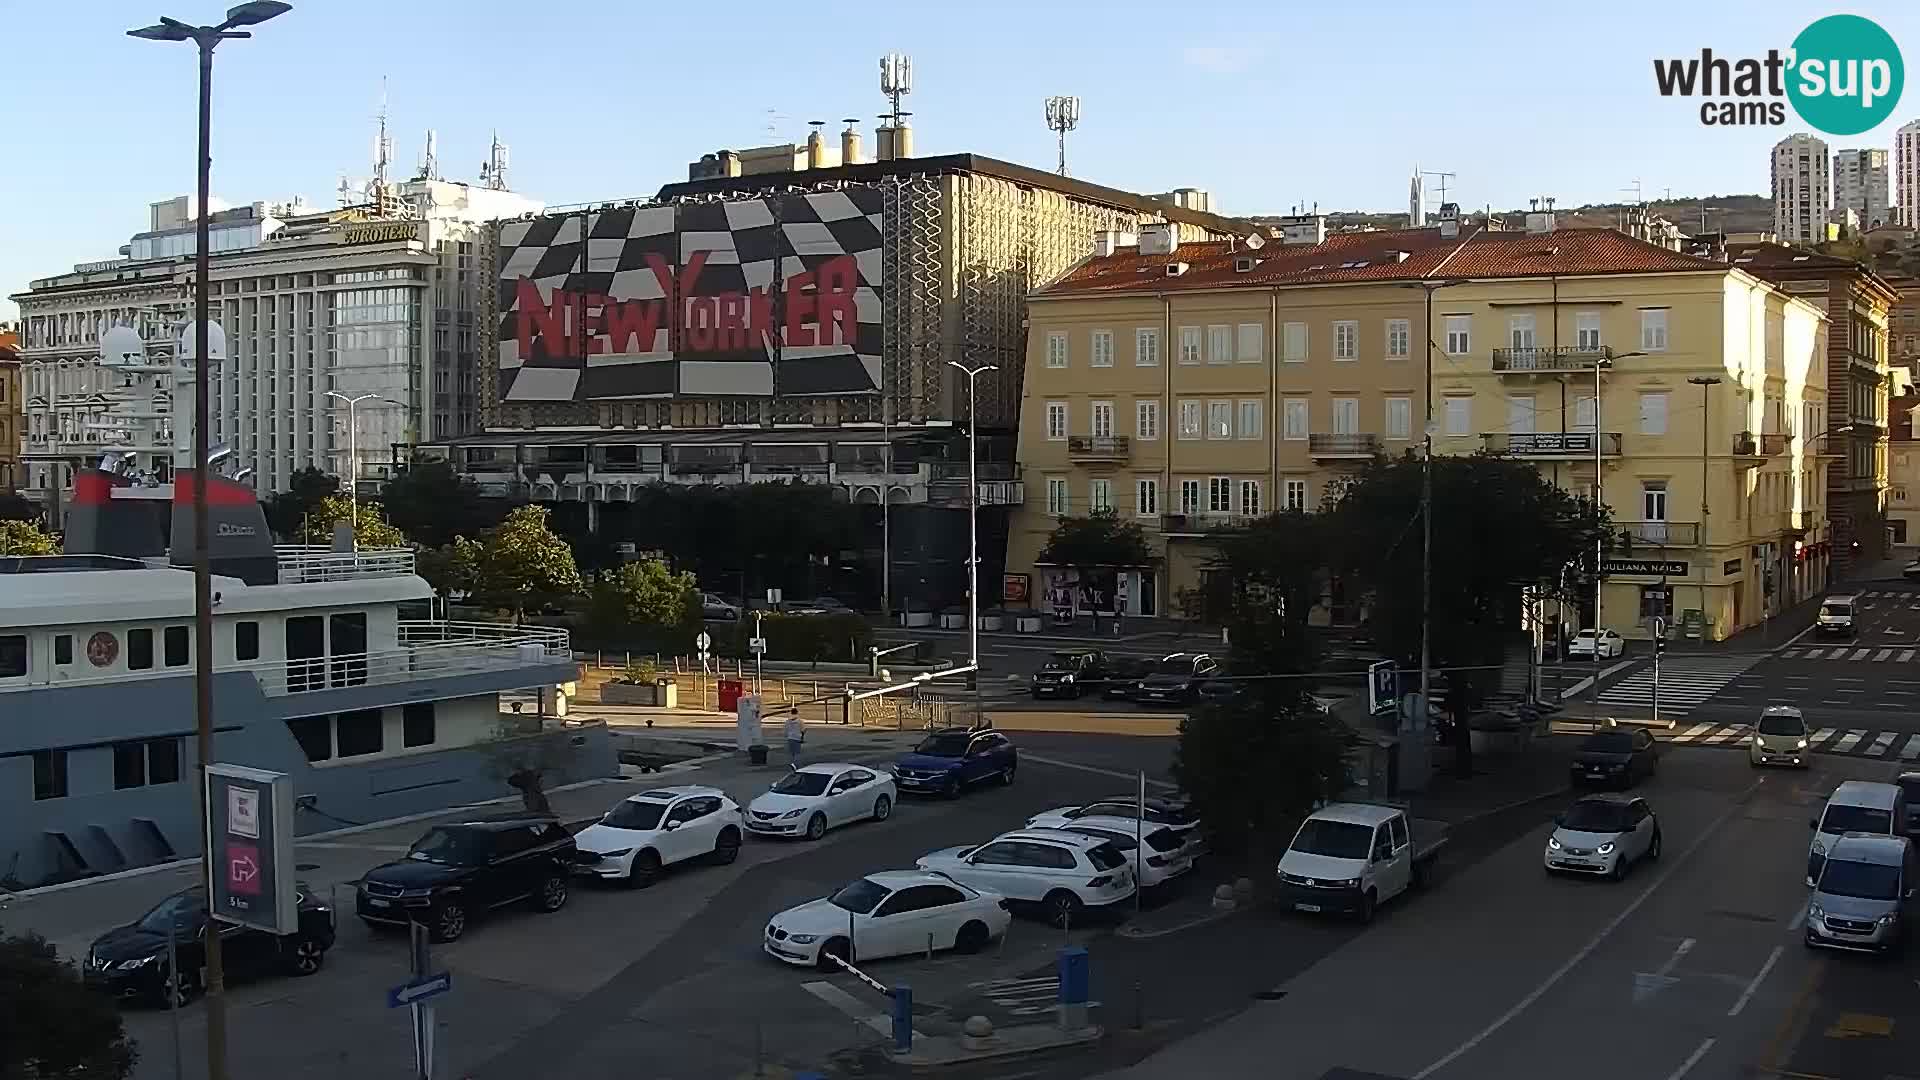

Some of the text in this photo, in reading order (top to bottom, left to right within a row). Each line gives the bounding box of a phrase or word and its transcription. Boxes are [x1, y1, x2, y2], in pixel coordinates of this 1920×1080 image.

[518, 250, 858, 360] NEW YORKER
[1602, 563, 1683, 573] JULIANA NAILS
